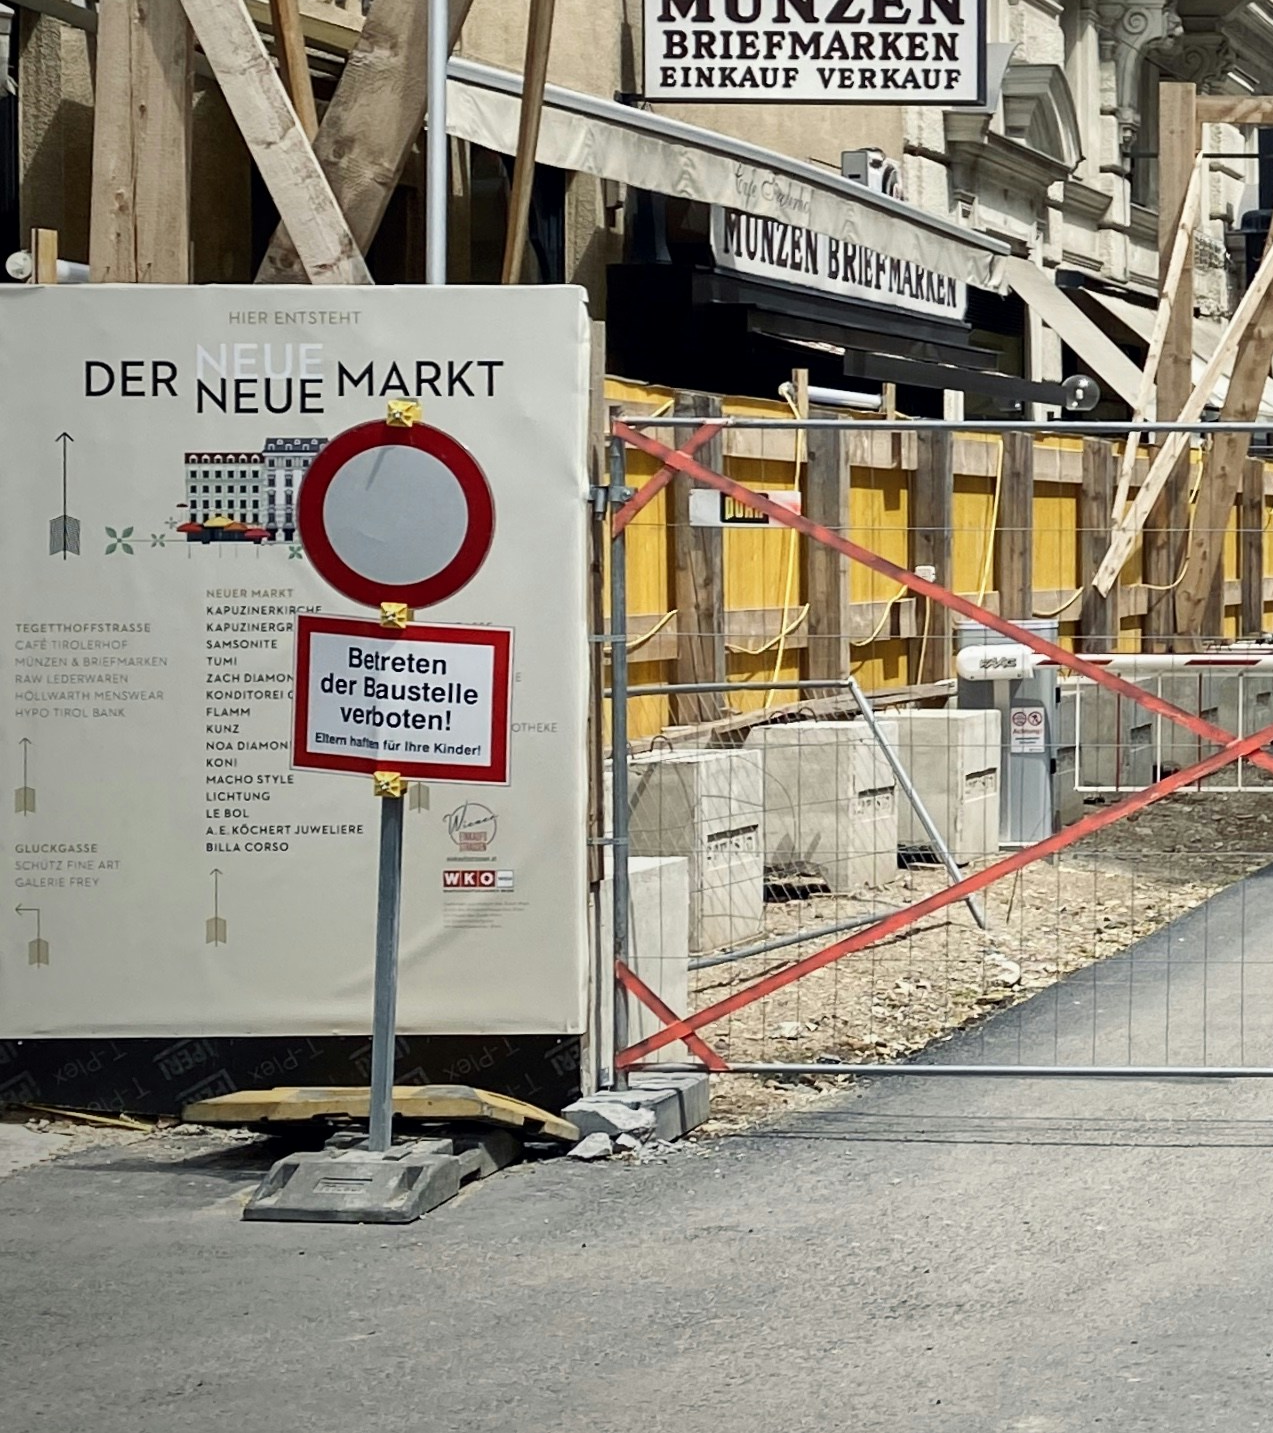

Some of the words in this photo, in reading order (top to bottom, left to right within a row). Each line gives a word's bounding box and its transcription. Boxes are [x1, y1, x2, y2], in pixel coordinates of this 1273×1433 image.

[662, 29, 959, 62] BRIEFMARKEN
[659, 67, 799, 88] EINKAUF
[818, 68, 961, 90] VERKAUF
[827, 238, 957, 308] BRIEFMARKEN
[229, 311, 268, 325] HIER
[274, 311, 363, 325] ENTSTEHT
[196, 343, 324, 379] NEUE
[85, 361, 178, 397] DER
[197, 379, 324, 414] NEUE
[337, 361, 504, 397] MARKT
[206, 588, 247, 598] NEUER
[251, 588, 294, 598] MARKT
[15, 623, 152, 633] TEGETTHOFFSTRASSE
[206, 622, 294, 632] KAPUZINERGR
[206, 639, 278, 649] SAMSONITE
[71, 657, 79, 667] &
[206, 656, 238, 666] TUMI
[348, 646, 448, 675] Betreten
[15, 674, 43, 684] RAW
[47, 674, 129, 684] LEDERWAREN
[206, 673, 240, 683] ZACH
[244, 673, 294, 683] DIAMON
[320, 673, 357, 695] der
[364, 676, 479, 705] Baustelle
[206, 690, 284, 700] KONDITOREI
[15, 708, 50, 718] HYPO
[53, 708, 88, 718] TIROL
[92, 708, 126, 718] BANK
[206, 707, 251, 717] FLAMM
[340, 705, 452, 731] verboten!
[206, 724, 240, 734] KUNZ
[511, 722, 558, 734] OTHEKE
[206, 741, 234, 751] NOA
[237, 741, 292, 751] DIAMON
[383, 738, 401, 752] für
[405, 742, 430, 753] Ihre
[434, 743, 481, 757] Kinder!
[206, 758, 238, 768] KONI
[206, 775, 253, 785] MACHO
[257, 774, 294, 784] STYLE
[206, 792, 271, 802] LICHTUNG
[206, 809, 220, 819] LE
[224, 809, 250, 819] BOL
[232, 823, 291, 836] KÖCHERT
[294, 825, 364, 836] JUWELIERE
[206, 842, 241, 853] BILLA
[244, 842, 289, 853] CORSO
[444, 871, 495, 887] WKO
